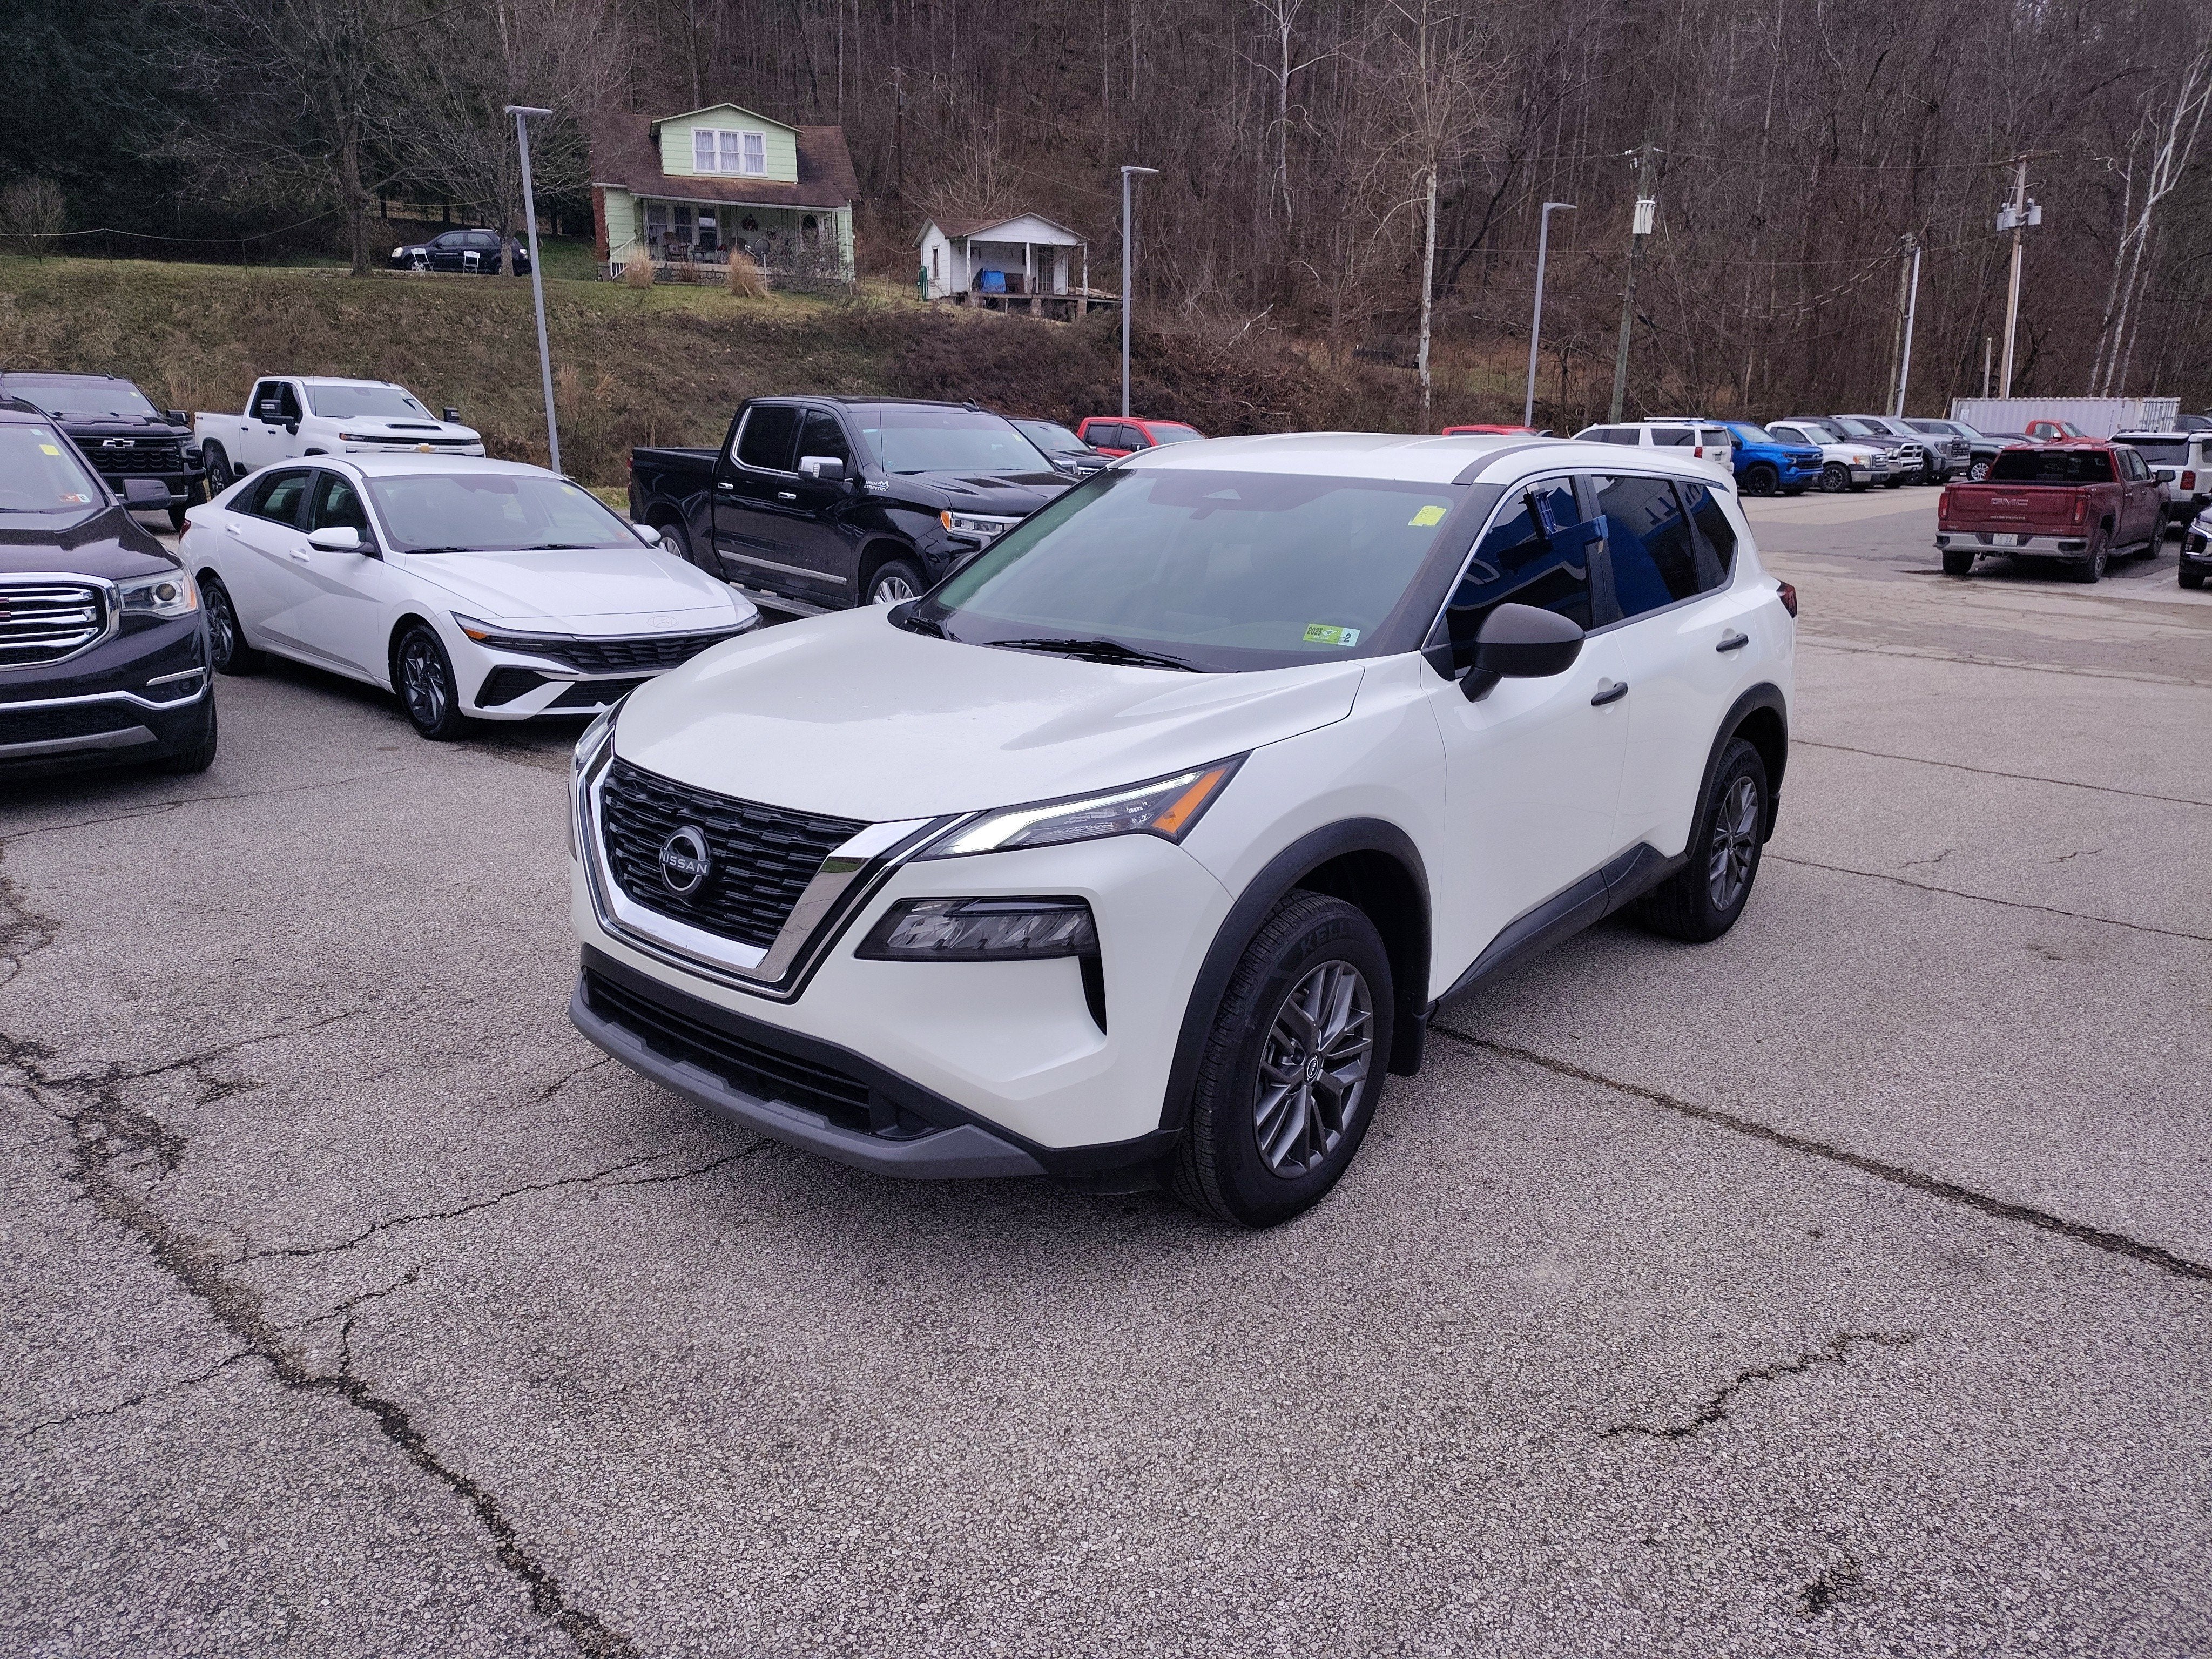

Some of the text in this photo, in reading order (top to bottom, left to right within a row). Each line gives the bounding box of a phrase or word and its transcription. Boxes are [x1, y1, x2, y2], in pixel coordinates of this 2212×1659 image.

[1990, 498, 2028, 506] GMC
[1306, 626, 1323, 636] 2023
[1344, 633, 1351, 643] 2
[659, 851, 707, 874] NISSAN
